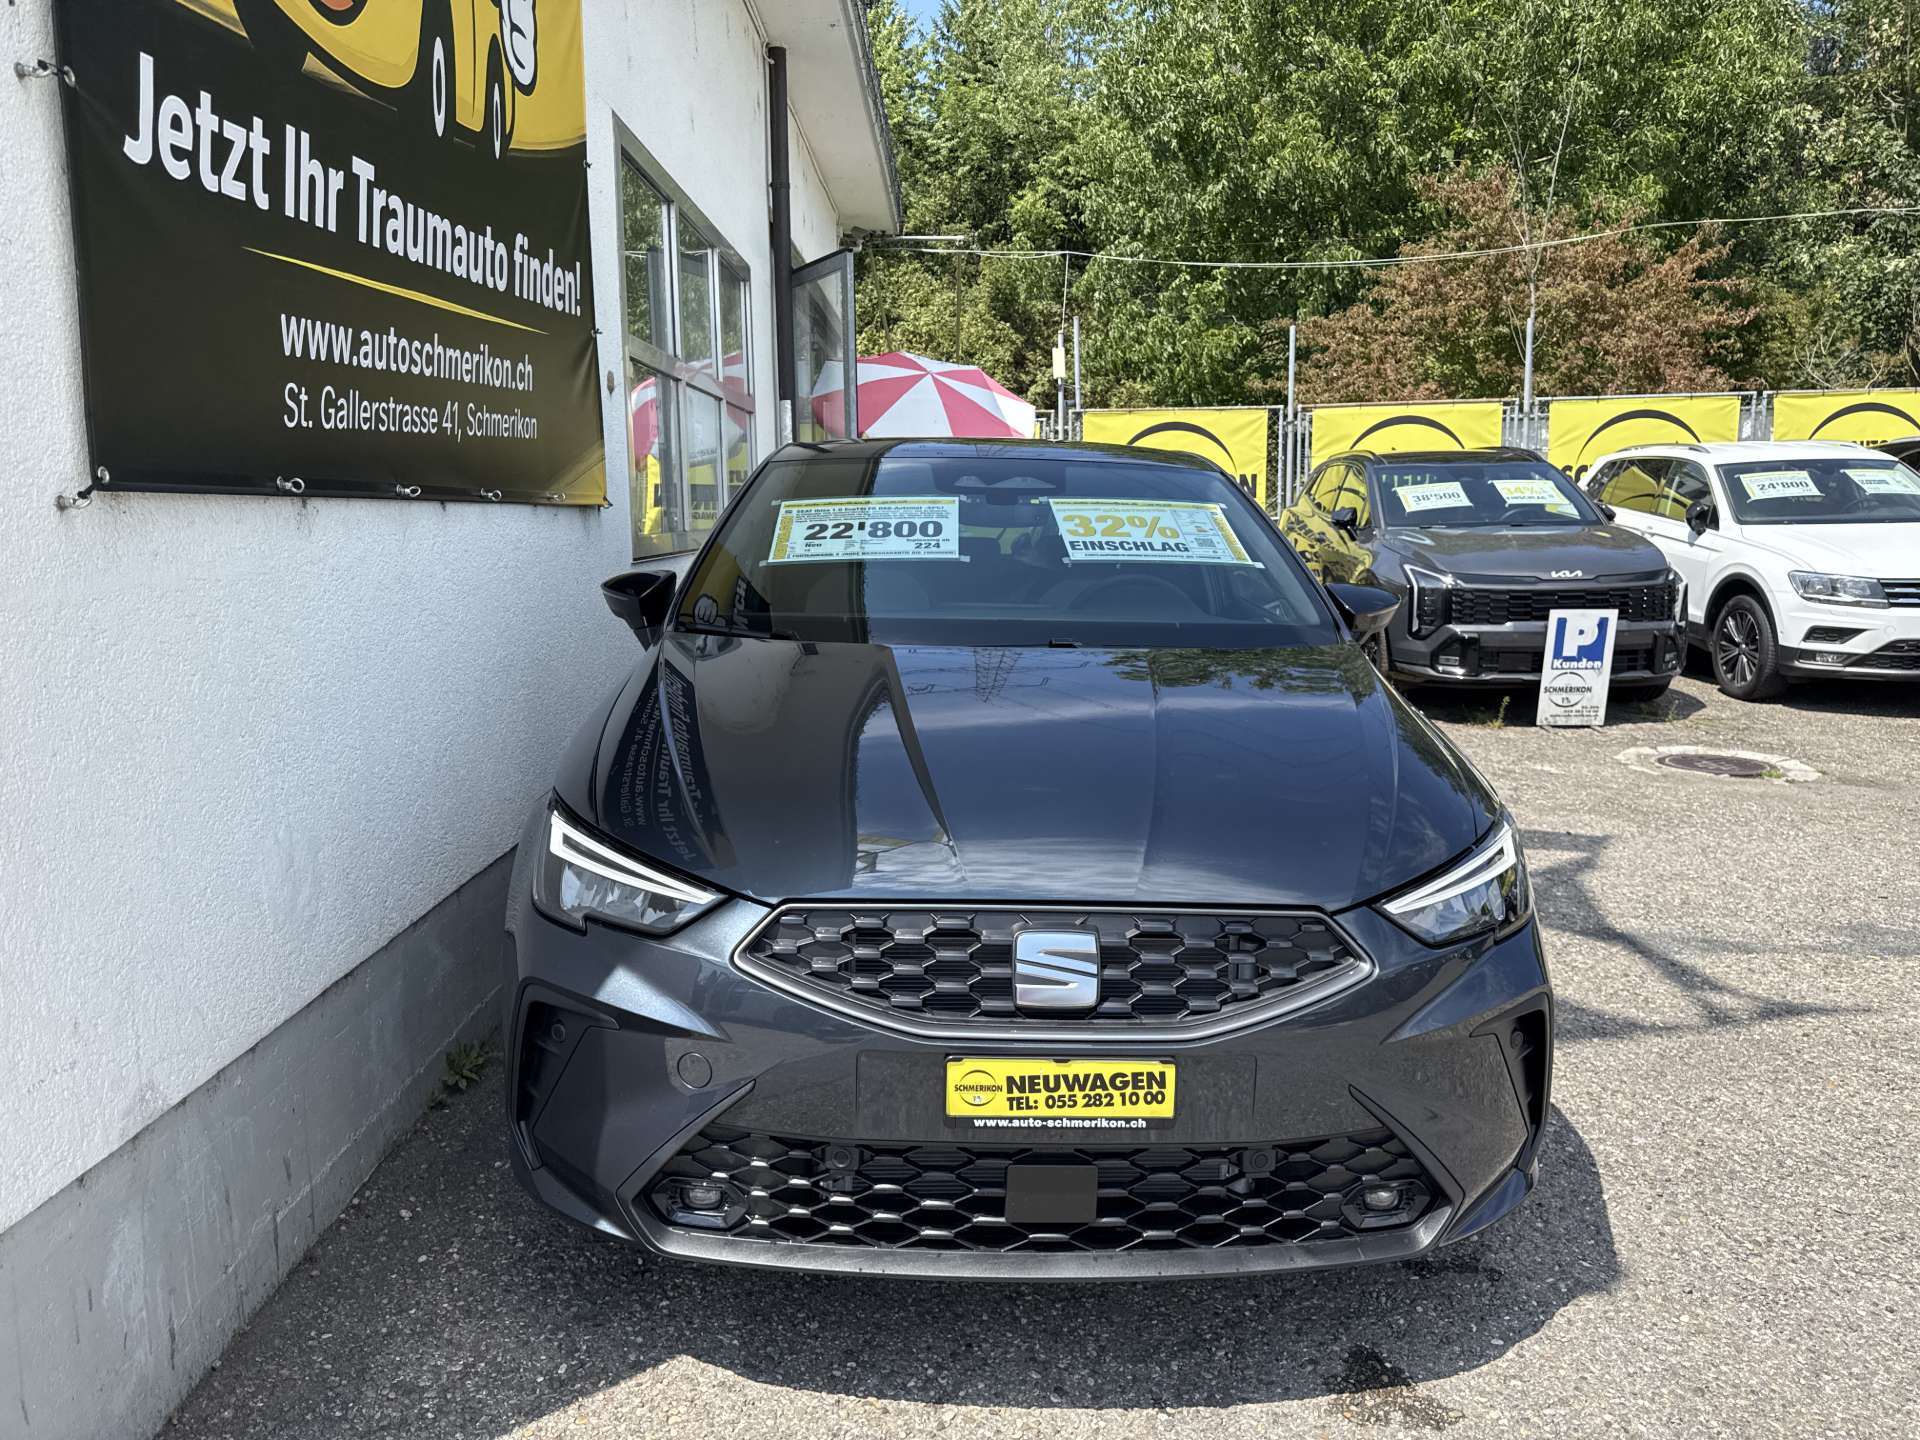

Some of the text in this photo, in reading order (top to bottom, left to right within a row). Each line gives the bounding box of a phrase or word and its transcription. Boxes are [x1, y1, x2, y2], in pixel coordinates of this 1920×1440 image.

[123, 51, 582, 317] Jetzt Ihr Traumauto finden!
[280, 313, 534, 392] www.autoschmerikon.ch
[283, 382, 538, 443] St. Gallerstrasse 41, Schmerikon
[1757, 482, 1809, 491] 24'800
[1412, 491, 1461, 503] 38'500
[804, 520, 943, 541] 22'800
[1062, 514, 1180, 540] 32%
[914, 542, 941, 550] 224
[1069, 540, 1190, 553] EINSCHLAG
[1562, 617, 1599, 657] P
[1553, 659, 1602, 669] Kunden
[1544, 686, 1592, 694] SCHMERIKON
[954, 1084, 1002, 1093] SCHMERIKON
[1006, 1071, 1166, 1094] NEUWAGEN
[1007, 1091, 1166, 1111] TEL: 055 282 10 00
[974, 1118, 1147, 1128] www.auto-schmerikon.ch
